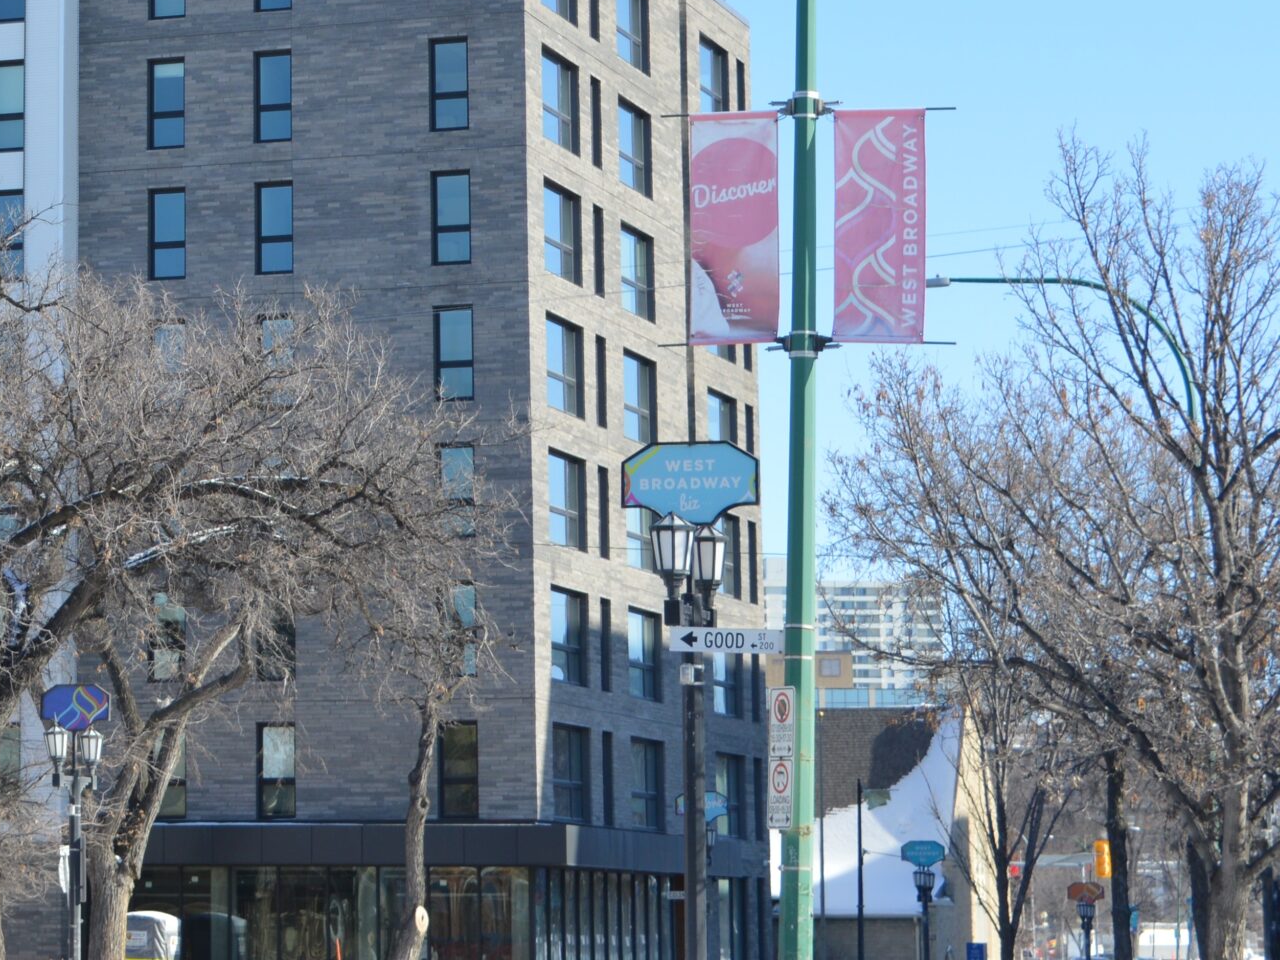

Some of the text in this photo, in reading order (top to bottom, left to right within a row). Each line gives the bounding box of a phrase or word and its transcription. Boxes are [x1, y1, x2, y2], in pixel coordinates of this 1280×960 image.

[691, 176, 776, 208] Discover
[901, 124, 918, 327] WEST BROADWAY
[665, 459, 716, 472] WEST
[639, 476, 742, 490] BROADWAY
[679, 493, 701, 511] biz
[704, 632, 745, 649] GOOD
[759, 642, 774, 650] 200
